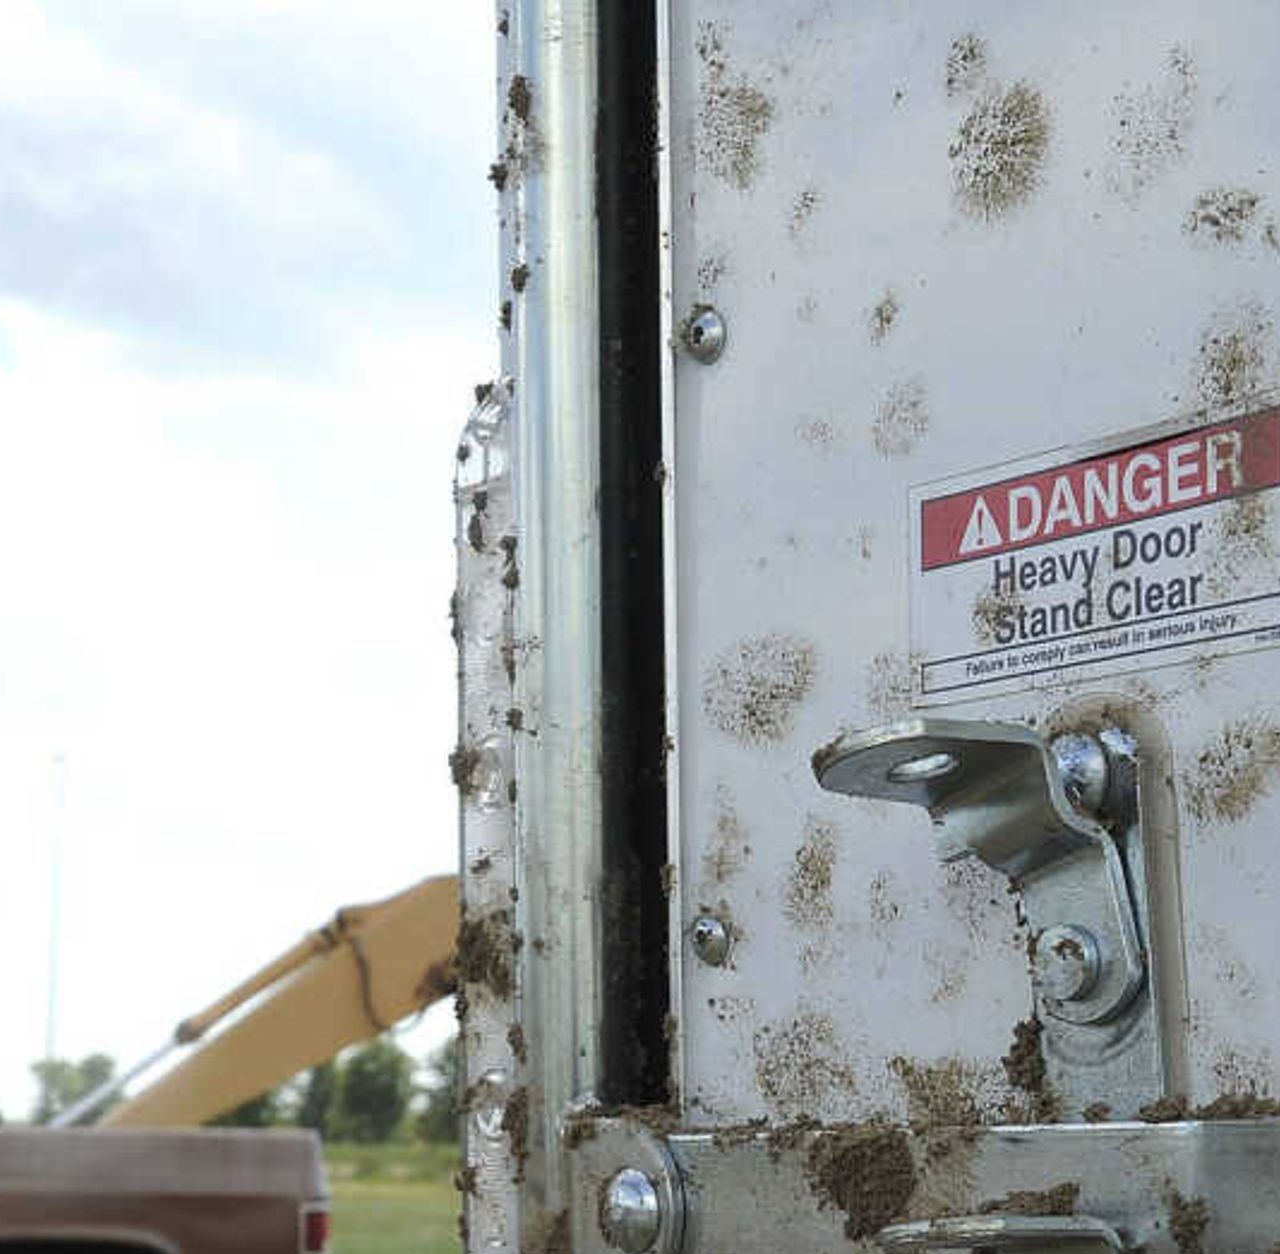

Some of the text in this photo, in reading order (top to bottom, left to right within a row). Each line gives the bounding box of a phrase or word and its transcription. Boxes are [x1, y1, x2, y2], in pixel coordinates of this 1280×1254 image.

[1007, 430, 1243, 543] DANGER
[993, 520, 1203, 597] Heavy Door
[965, 613, 1237, 678] Failure to comply can result in serious injury
[994, 573, 1204, 645] Stand Clear
